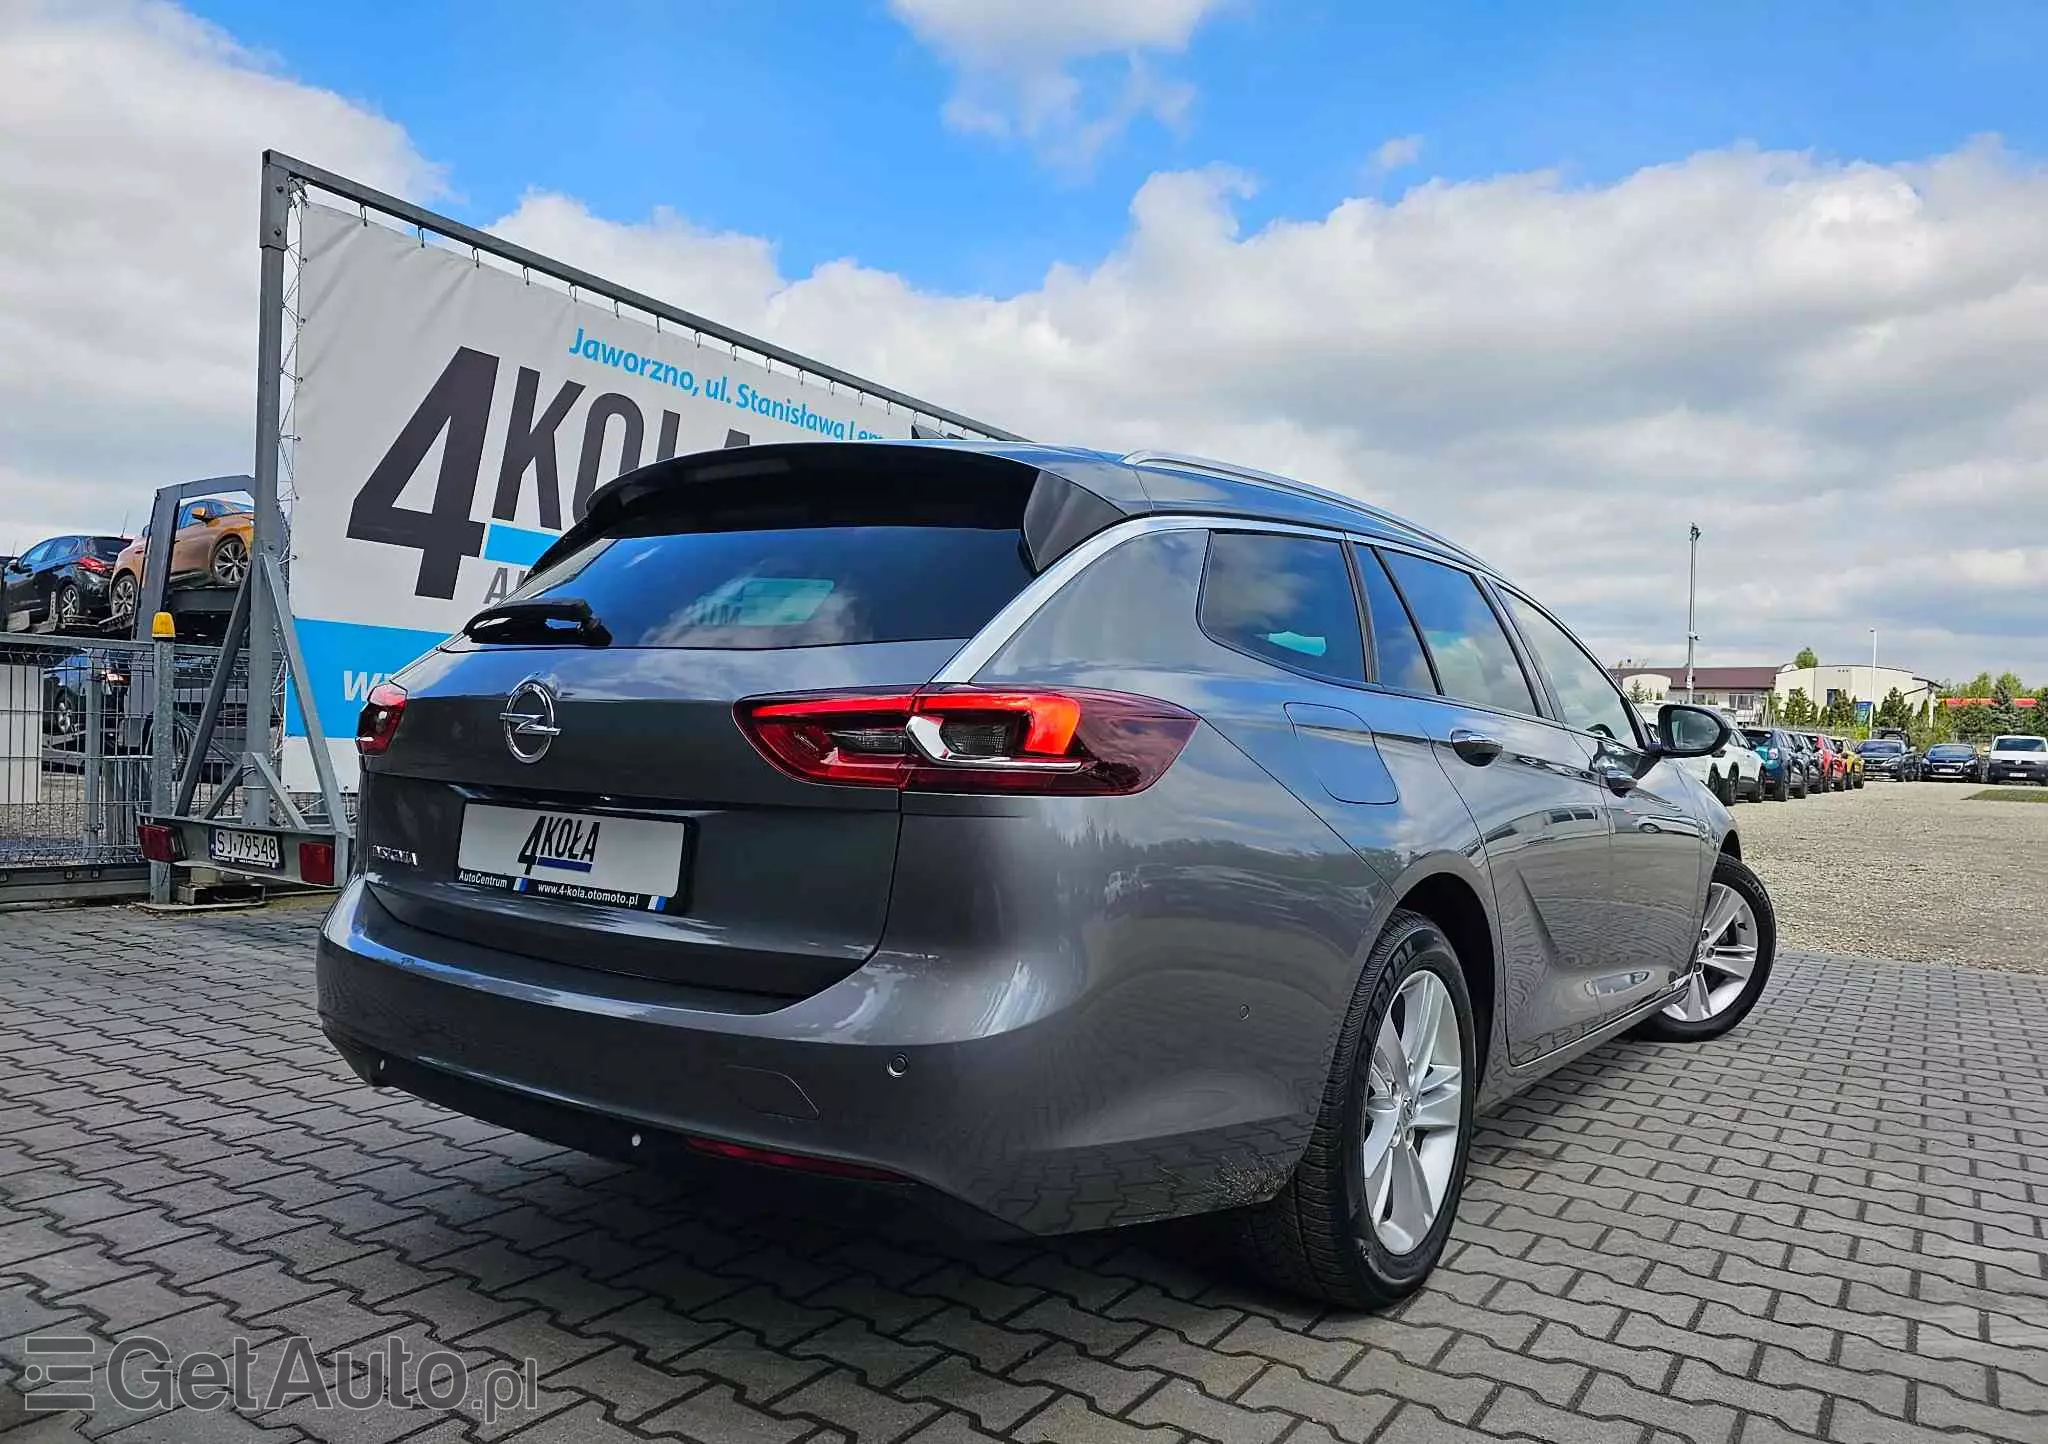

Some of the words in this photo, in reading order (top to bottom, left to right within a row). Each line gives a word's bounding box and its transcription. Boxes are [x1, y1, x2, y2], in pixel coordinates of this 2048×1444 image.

[569, 328, 700, 397] Jaworzno,
[705, 375, 731, 404] ul.
[736, 383, 845, 440] Stanisława
[458, 871, 508, 888] AutoCentrum
